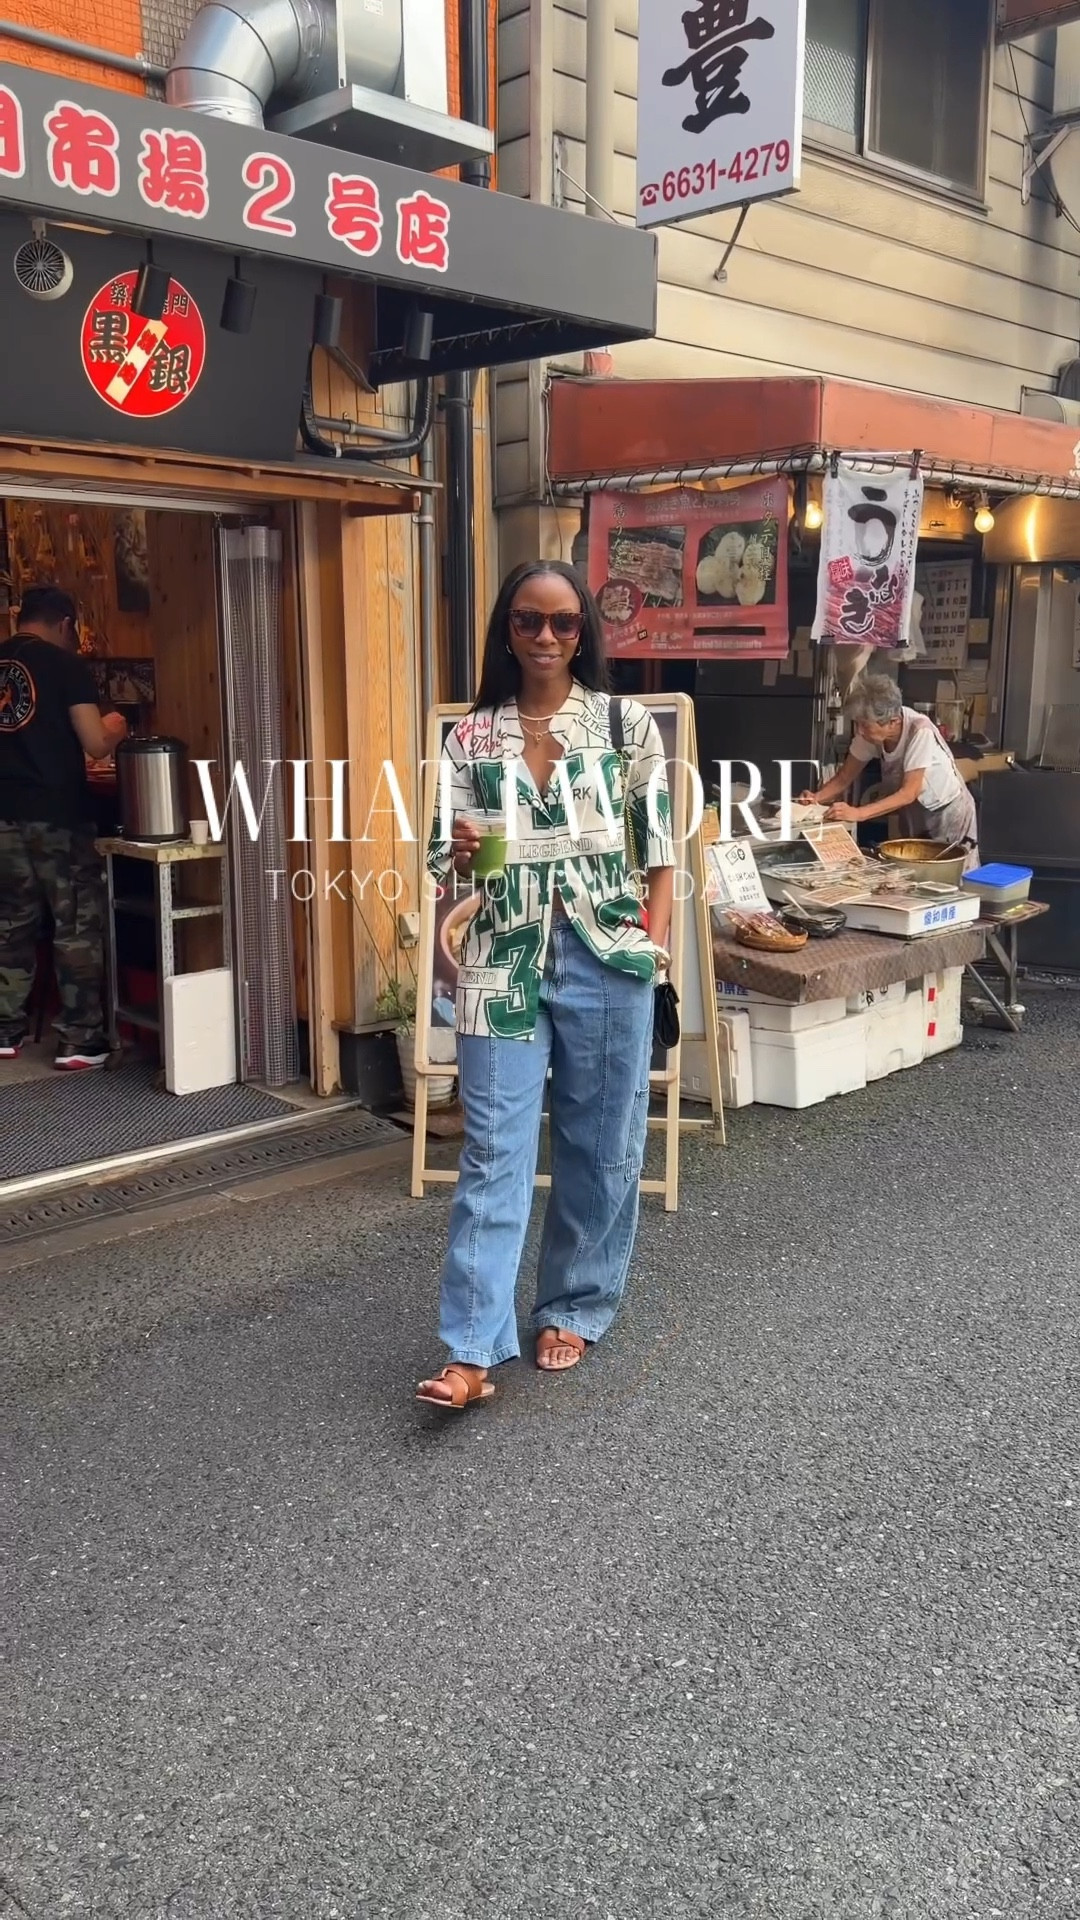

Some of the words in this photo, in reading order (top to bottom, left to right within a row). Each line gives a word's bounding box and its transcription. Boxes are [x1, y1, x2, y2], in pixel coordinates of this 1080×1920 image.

[662, 139, 790, 202] 6631-4279
[838, 486, 899, 636] うなぎ
